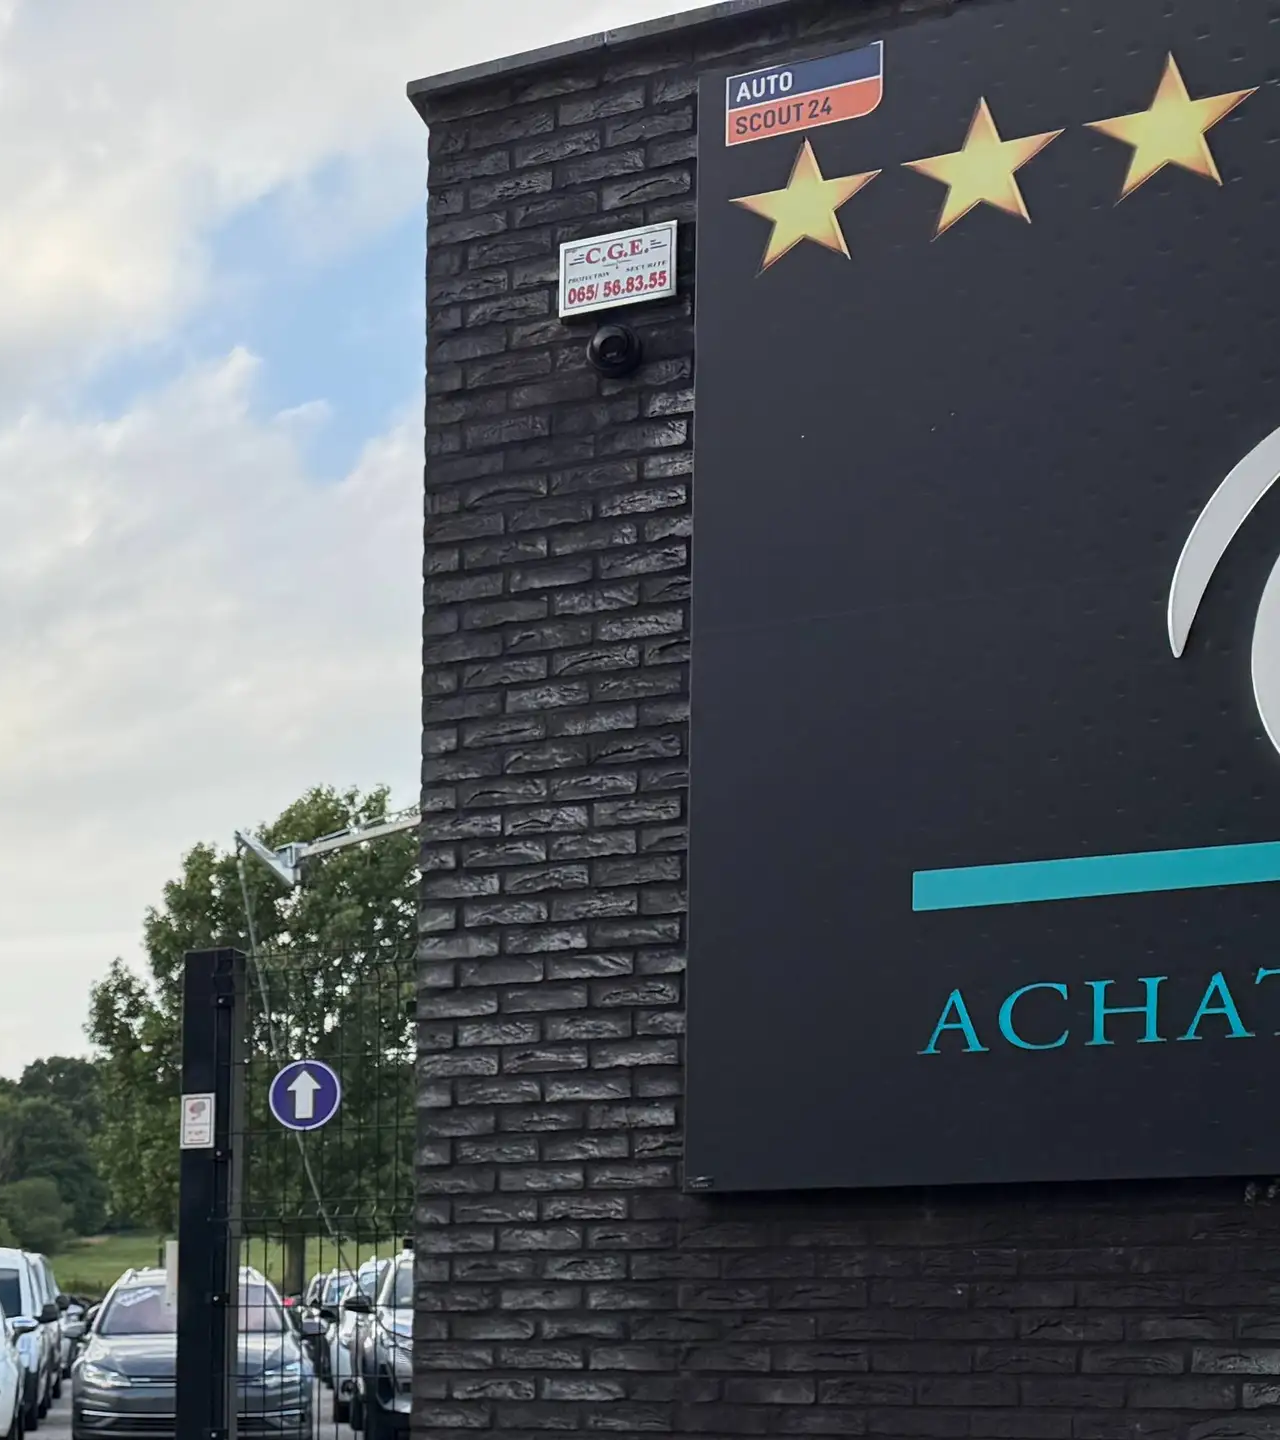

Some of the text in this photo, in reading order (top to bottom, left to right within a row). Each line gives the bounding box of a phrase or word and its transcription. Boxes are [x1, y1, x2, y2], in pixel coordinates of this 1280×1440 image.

[736, 71, 793, 102] AUTO
[735, 96, 833, 135] SCOUT 24
[585, 238, 650, 265] C.G.E.
[567, 270, 667, 304] 065/ 56.83.55
[568, 271, 611, 284] PROTECTION
